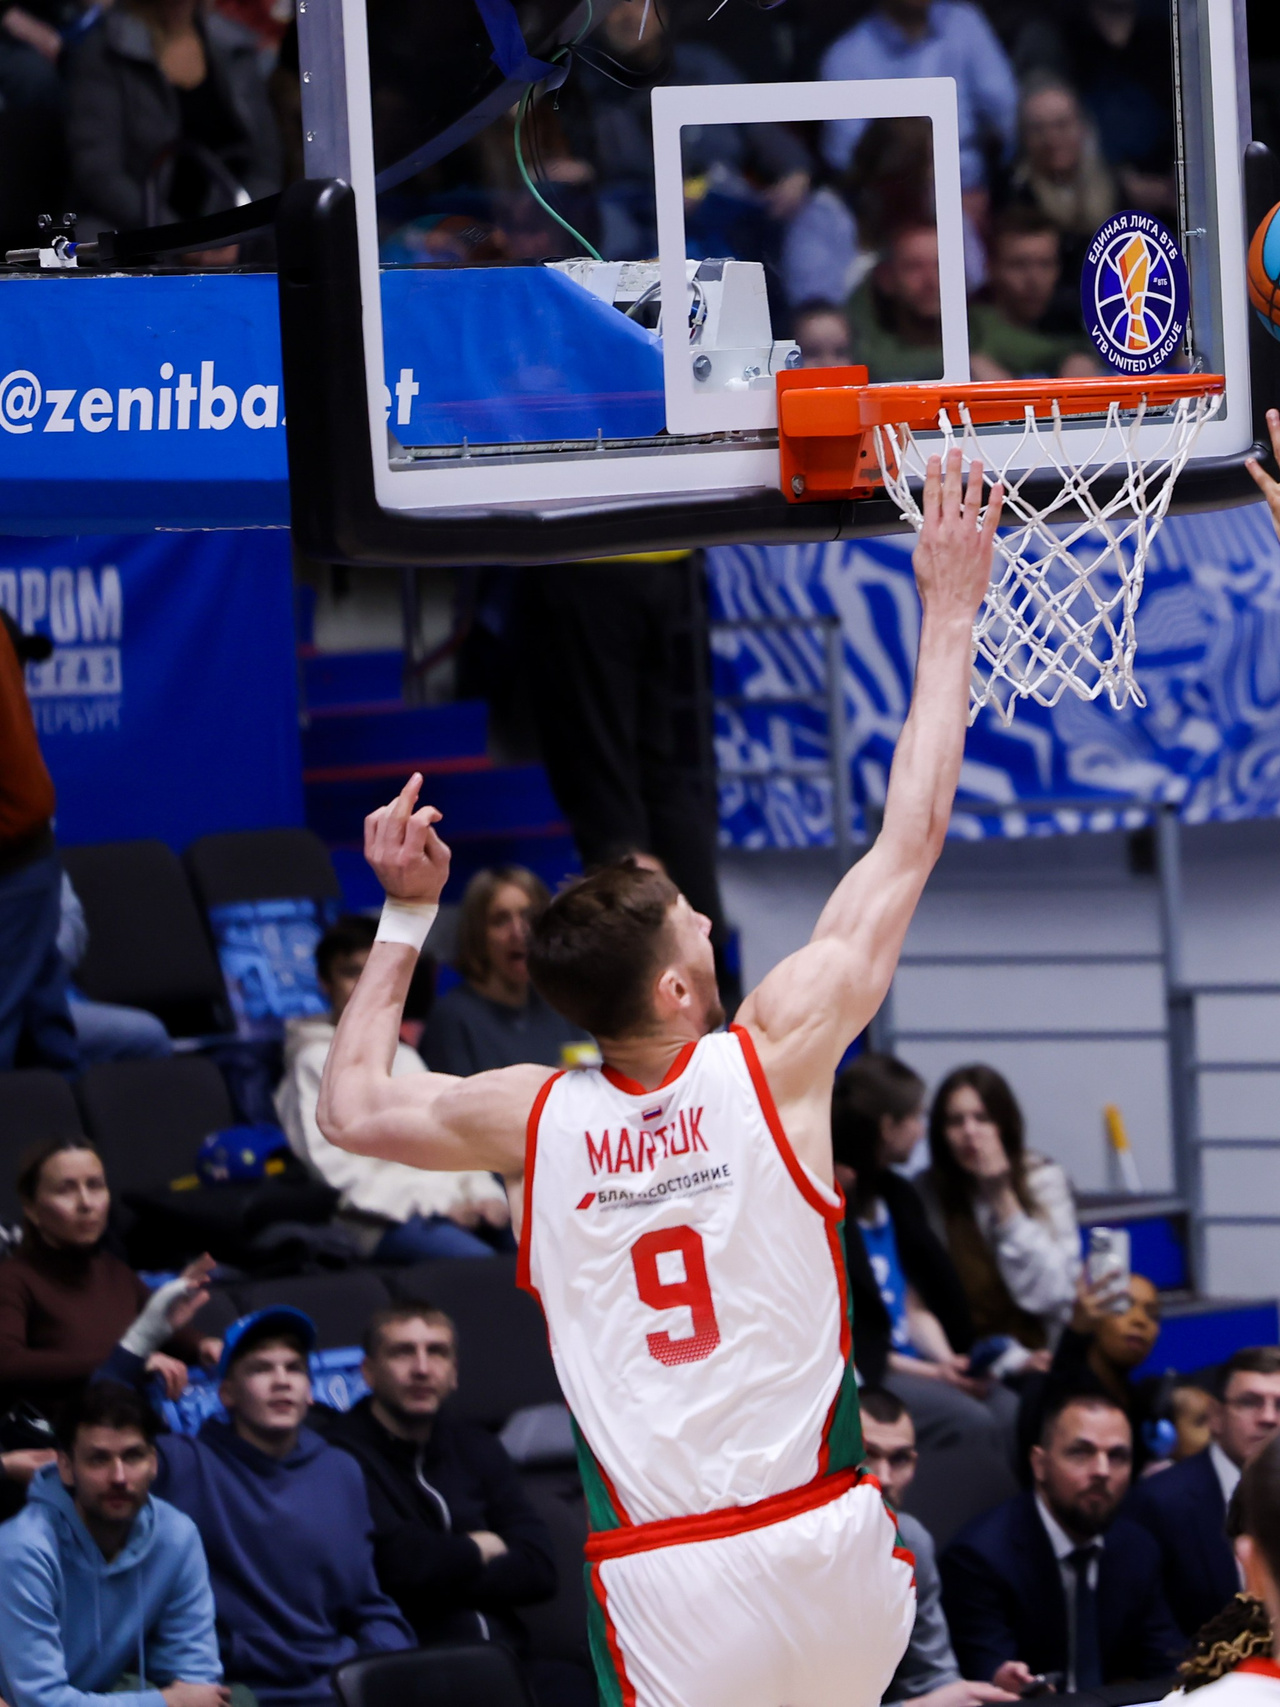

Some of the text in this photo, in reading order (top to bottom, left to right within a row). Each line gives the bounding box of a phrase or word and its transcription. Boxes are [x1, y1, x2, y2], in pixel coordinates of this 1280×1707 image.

[1088, 214, 1178, 265] ЕДИНАЯ ЛИГА ВТБ
[1091, 321, 1183, 373] VTB UNITED LEAGUE
[631, 1224, 721, 1367] 9
